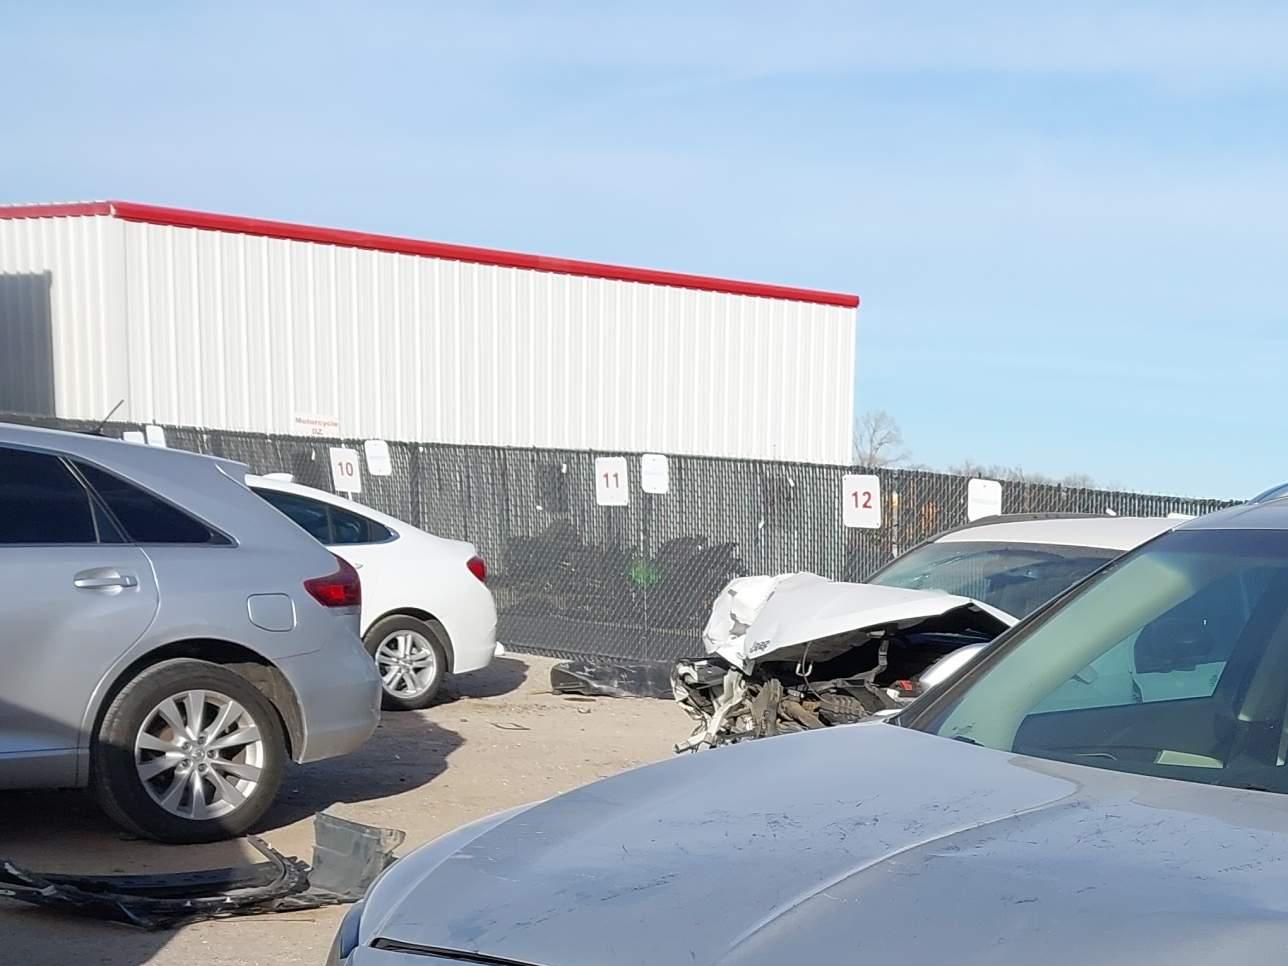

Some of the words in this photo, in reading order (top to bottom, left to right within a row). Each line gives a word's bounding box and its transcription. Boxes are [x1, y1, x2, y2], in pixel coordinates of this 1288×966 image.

[338, 462, 353, 476] 10
[603, 472, 619, 488] 11
[851, 491, 872, 508] 12
